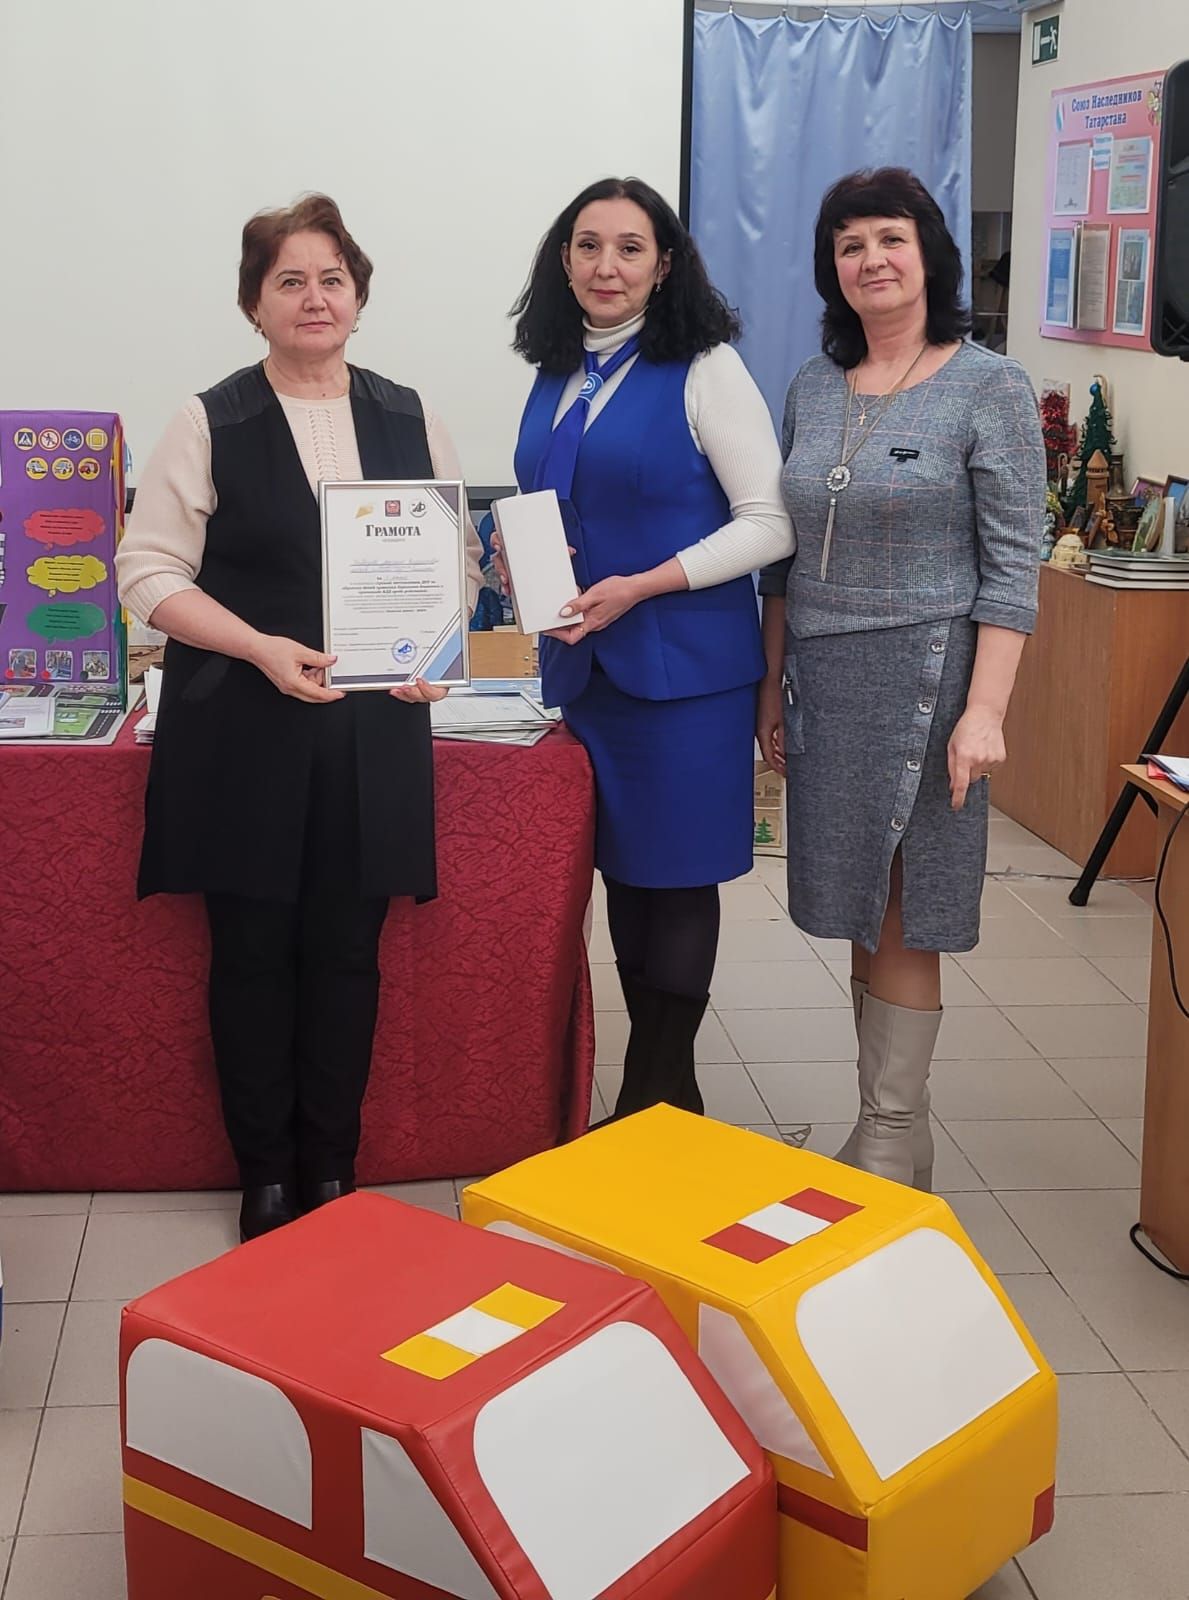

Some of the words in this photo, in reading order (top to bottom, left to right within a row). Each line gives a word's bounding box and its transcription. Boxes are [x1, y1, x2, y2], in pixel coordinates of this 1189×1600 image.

[1072, 98, 1090, 112] Союз
[1091, 90, 1142, 109] Наследников
[1085, 112, 1127, 130] Татарстана
